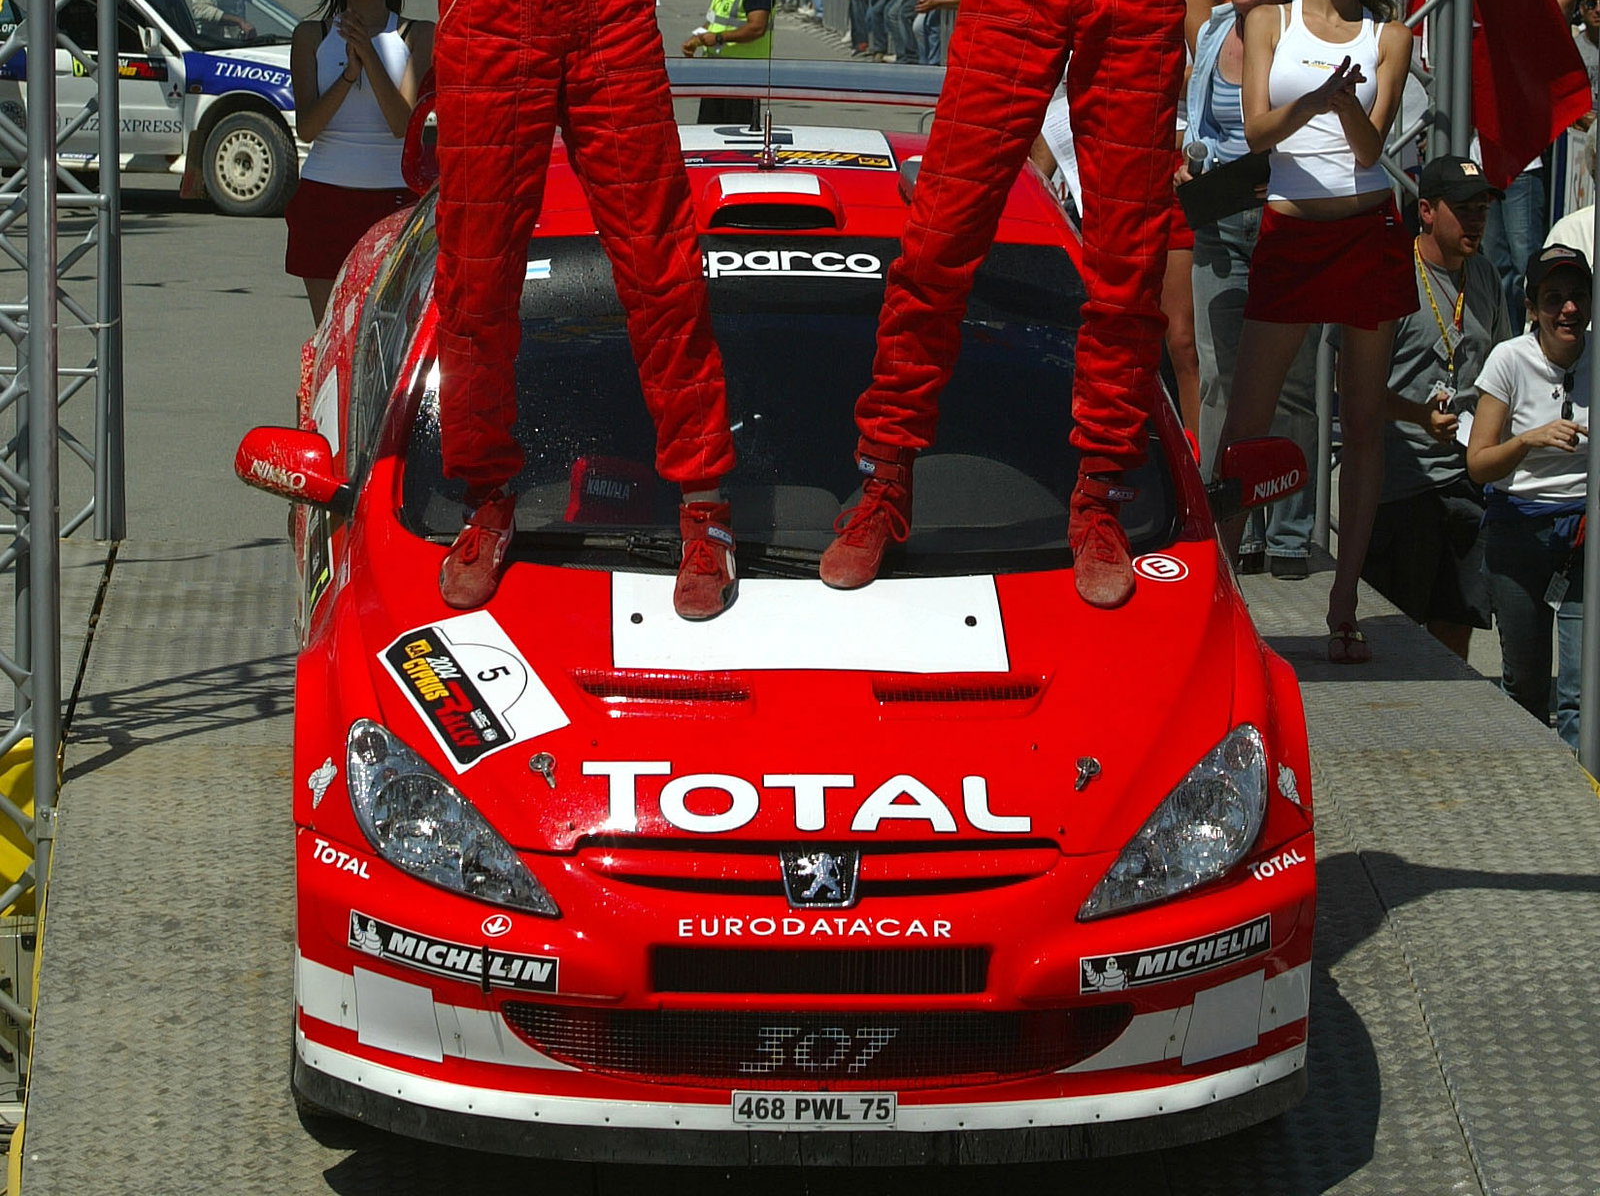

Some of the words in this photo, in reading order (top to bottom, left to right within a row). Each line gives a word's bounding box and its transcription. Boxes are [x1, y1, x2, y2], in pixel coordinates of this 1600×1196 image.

[250, 459, 306, 489] NIKKO
[1253, 469, 1300, 501] NIKKO
[425, 655, 462, 679] 2004
[477, 665, 511, 682] 5
[402, 657, 450, 702] CYPRUS
[434, 681, 481, 747] RALLY
[582, 760, 1032, 834] TOTAL
[313, 838, 371, 880] TOTAL
[1247, 848, 1306, 882] TOTAL
[678, 917, 952, 939] EURODATACAR
[387, 931, 553, 983] MICHELIN
[1134, 921, 1268, 977] MICHELIN
[739, 1027, 900, 1073] 307
[738, 1097, 786, 1121] 468
[795, 1097, 850, 1121] PWL
[860, 1097, 890, 1121] 75
